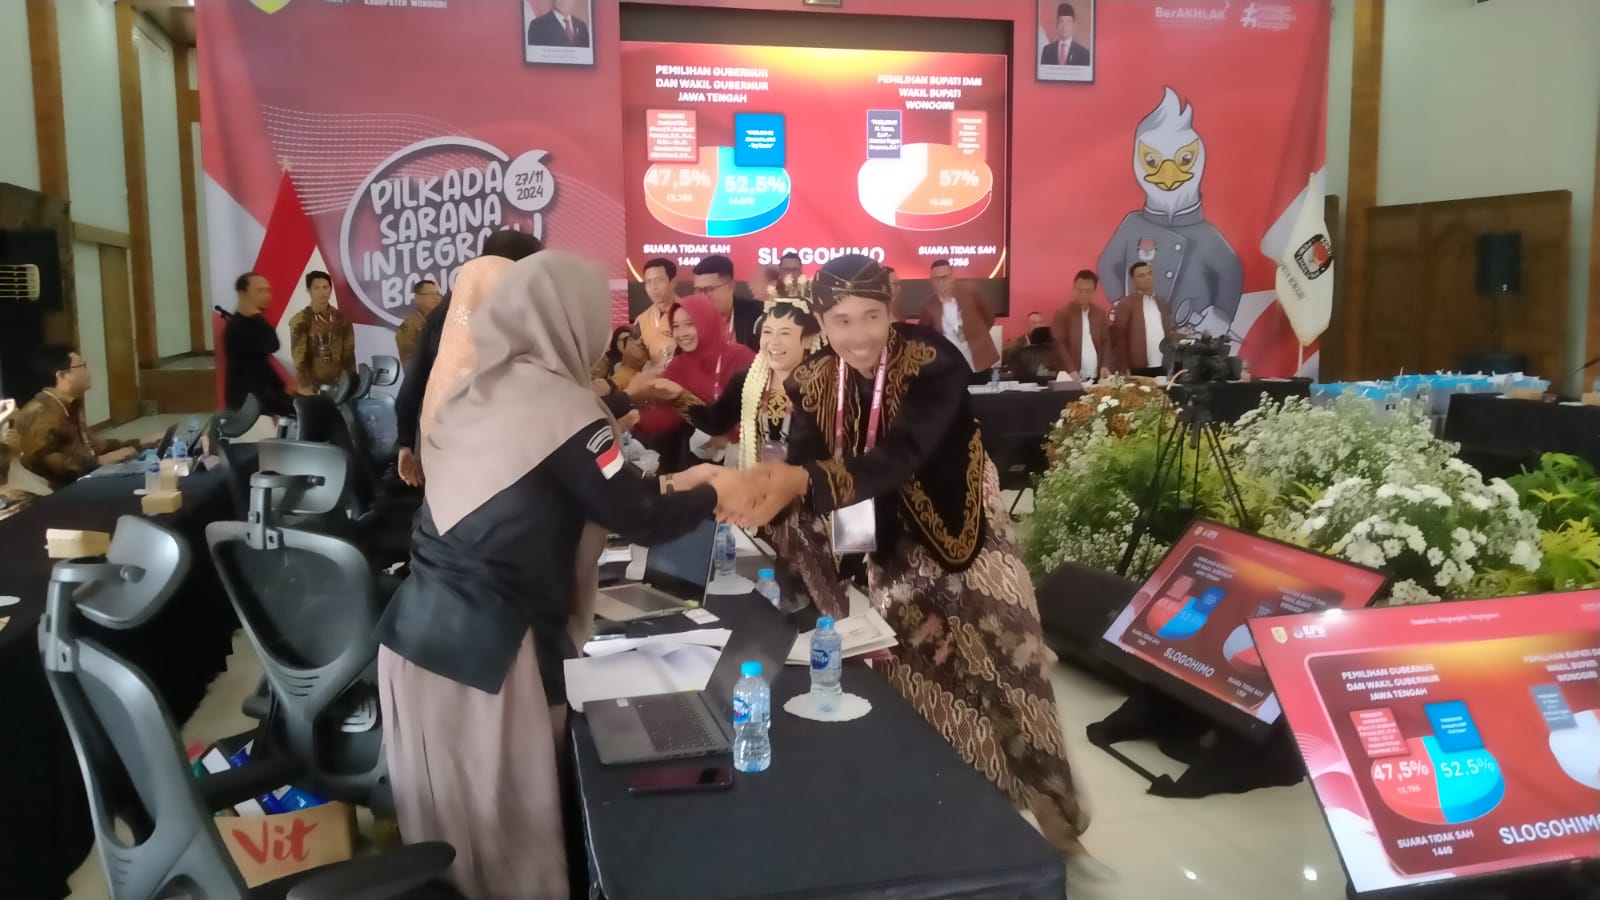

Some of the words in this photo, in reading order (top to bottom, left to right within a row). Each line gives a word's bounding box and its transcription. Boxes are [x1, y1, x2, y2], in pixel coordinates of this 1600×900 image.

[656, 65, 711, 77] PEMILIHAN
[713, 66, 768, 78] GUBERNUR
[656, 78, 678, 88] DAN
[680, 78, 712, 89] WAKIL
[714, 80, 768, 91] GUBERNUR
[877, 74, 928, 86] PEMILIHAN
[930, 76, 962, 86] BUPATI
[963, 77, 982, 86] DAN
[678, 92, 705, 102] JAWA
[706, 93, 748, 103] TENGAH
[900, 88, 928, 97] WAKIL
[930, 88, 962, 98] BUPATI
[906, 100, 954, 110] WONOGIRI
[514, 170, 544, 187] 27/11
[647, 168, 711, 188] 47,5%
[725, 176, 787, 194] 52,5%
[940, 170, 979, 187] 57%
[370, 160, 504, 214] PILKADA
[516, 187, 544, 200] 2024
[380, 194, 502, 246] SARANA
[643, 244, 677, 254] SUARA
[678, 244, 708, 254] TIDAK
[710, 244, 730, 254] SAH
[918, 246, 950, 255] SUARA
[950, 246, 976, 255] TIDAK
[978, 246, 996, 255] SAH
[1164, 648, 1214, 677] SLOGOHIMO
[1342, 668, 1388, 680] PEMILIHAN
[1346, 682, 1366, 692] DAN
[1366, 679, 1394, 689] WAKIL
[1394, 674, 1440, 686] GUBERNUR
[1370, 690, 1392, 701] JAWA
[1392, 688, 1428, 699] TENGAH
[1374, 760, 1430, 781] 47,5%
[232, 818, 318, 864] Vit
[1397, 835, 1428, 848] SUARA
[1428, 831, 1454, 844] TIDAK
[1455, 829, 1474, 840] SAH
